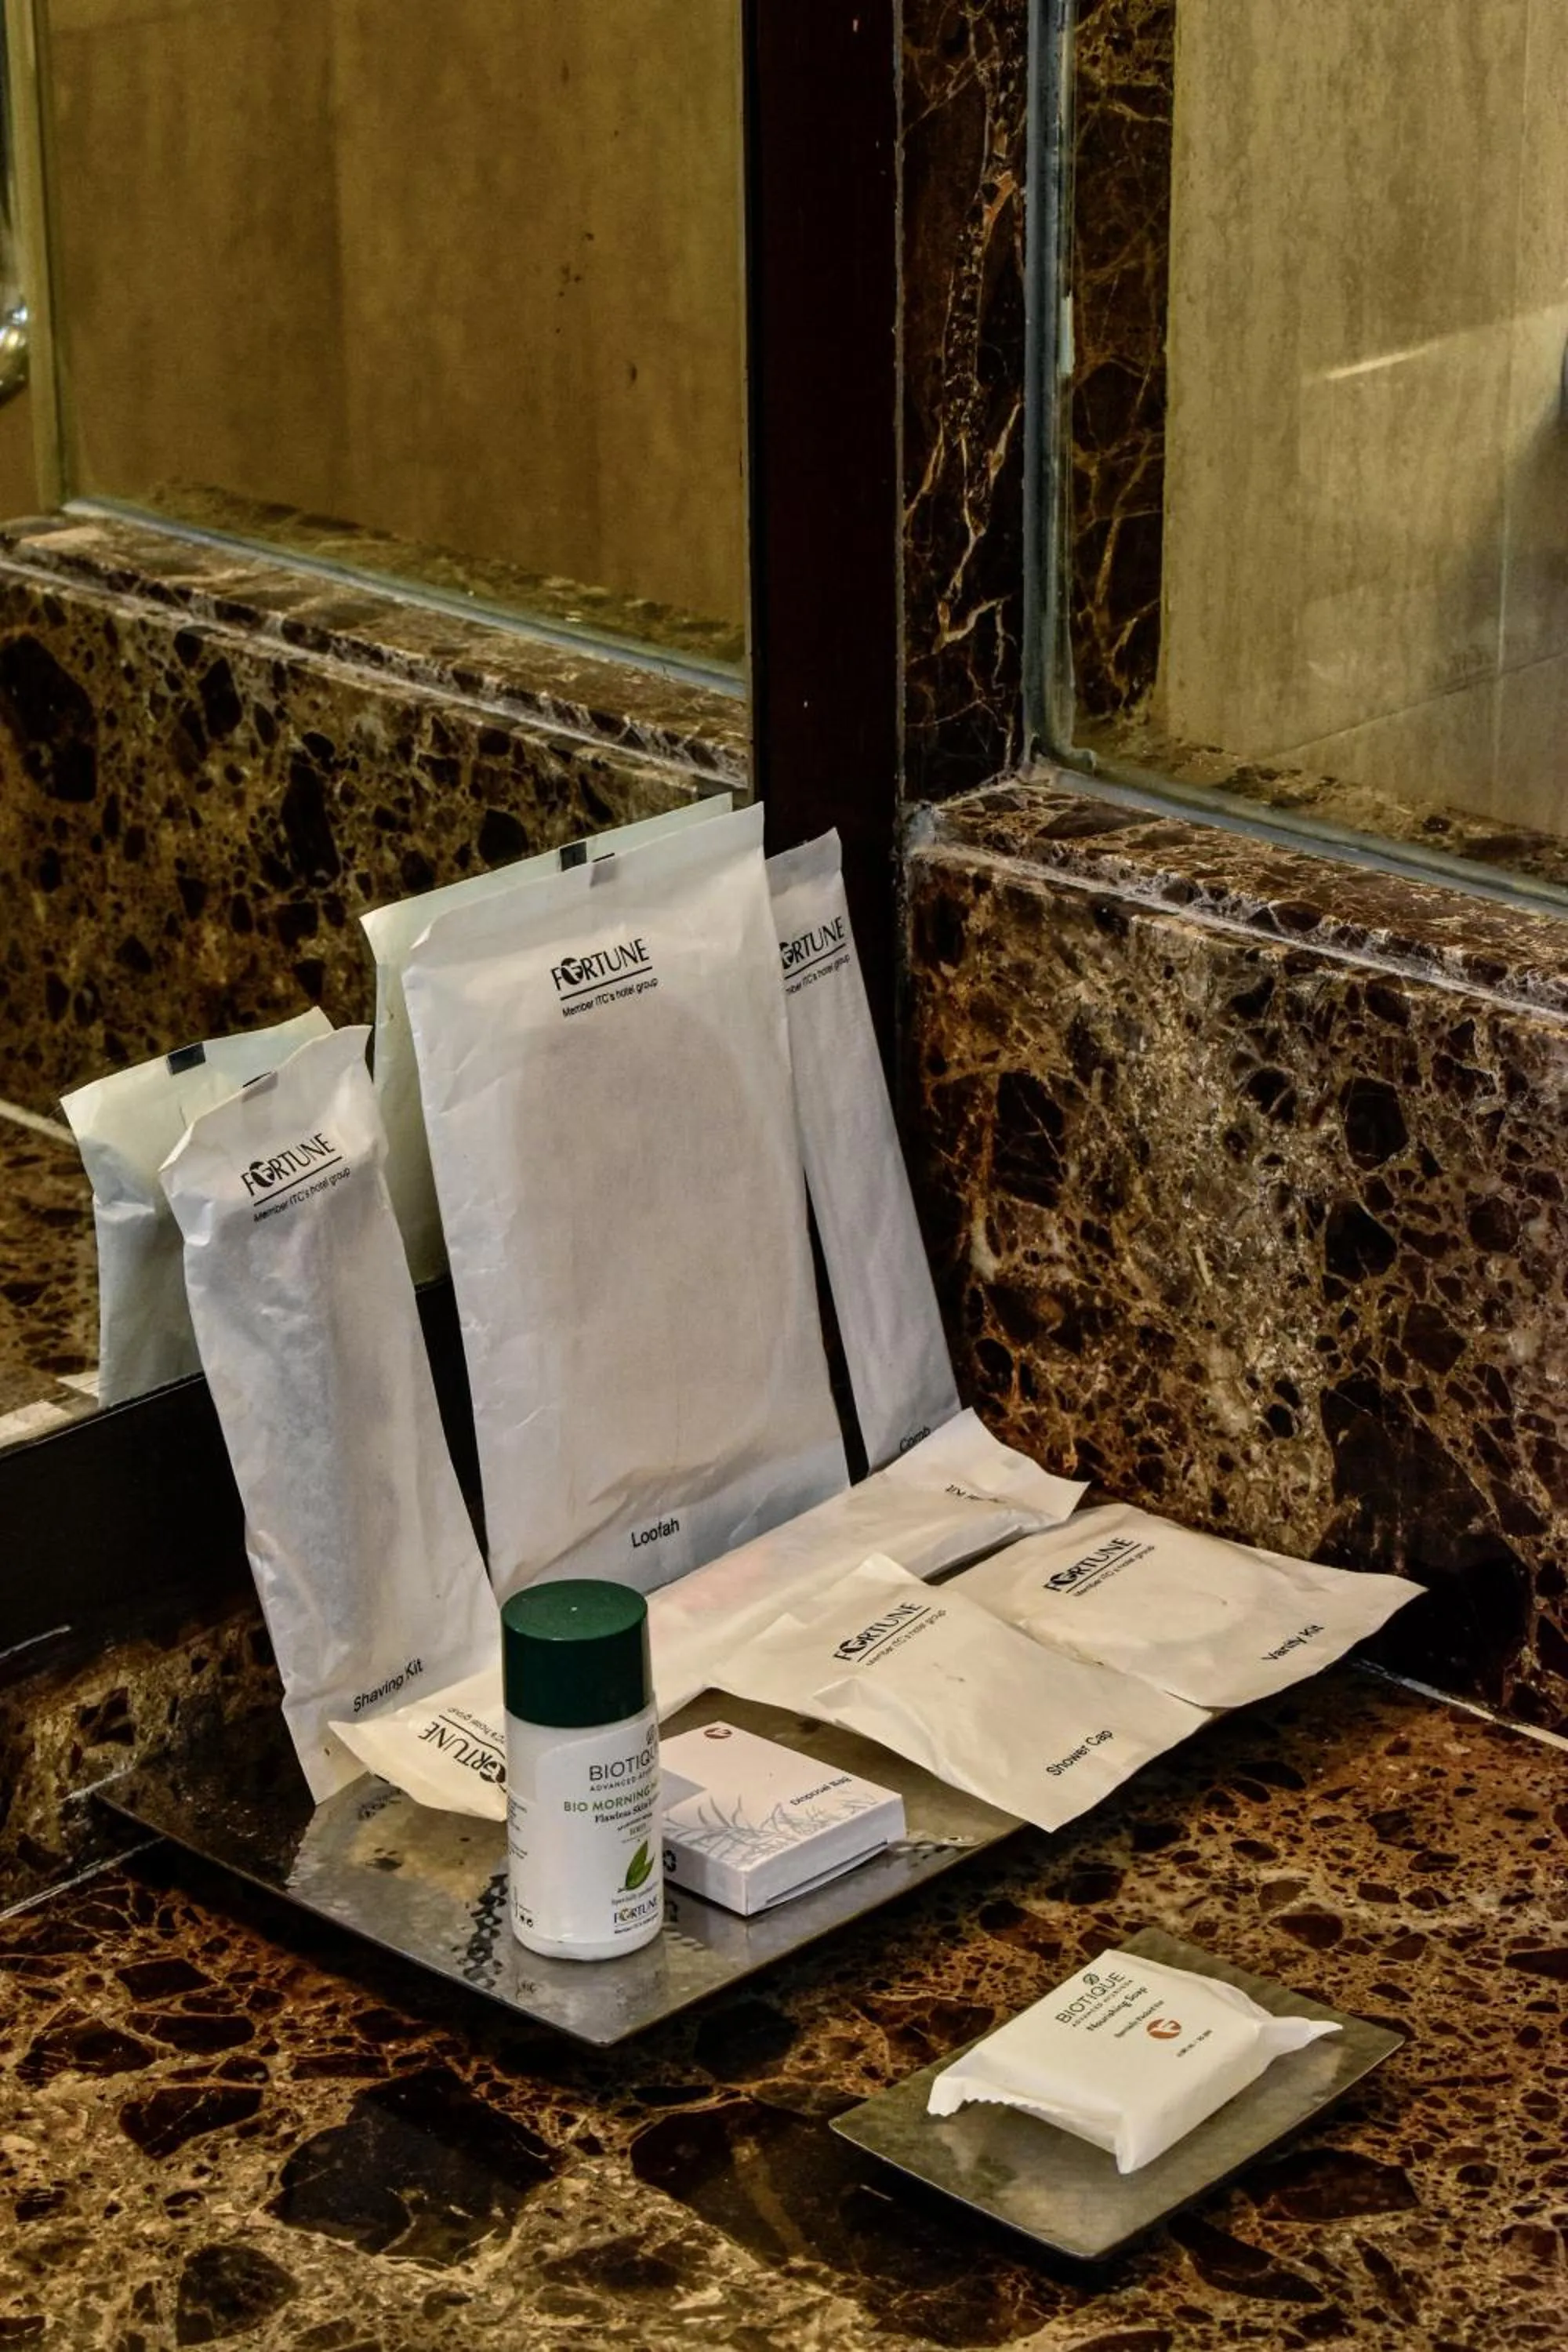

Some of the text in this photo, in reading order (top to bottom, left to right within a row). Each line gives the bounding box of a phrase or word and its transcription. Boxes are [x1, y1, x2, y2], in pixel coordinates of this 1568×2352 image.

[550, 938, 650, 991] FORTUNE
[779, 916, 845, 969] ORTUNE
[562, 978, 659, 1018] Member ITC's hotel group
[240, 1133, 336, 1196] FORTUNE
[253, 1167, 351, 1222] Member ITC's hotel group
[630, 1517, 681, 1548] Loofah
[1043, 1537, 1135, 1592] FORTUNE
[833, 1602, 924, 1661] FORTUNE
[1298, 1624, 1325, 1638] Kit
[353, 1657, 423, 1713] Shaving Kit
[1046, 1730, 1114, 1776] Shower Cap
[564, 1801, 588, 1813] BIO
[592, 1784, 651, 1811] MORNING
[590, 1776, 637, 1791] ADVANCED
[595, 1809, 632, 1824] Flawless
[1054, 1972, 1126, 2024] BIOTIQUE
[1086, 1986, 1149, 2032] Nourishing Soap
